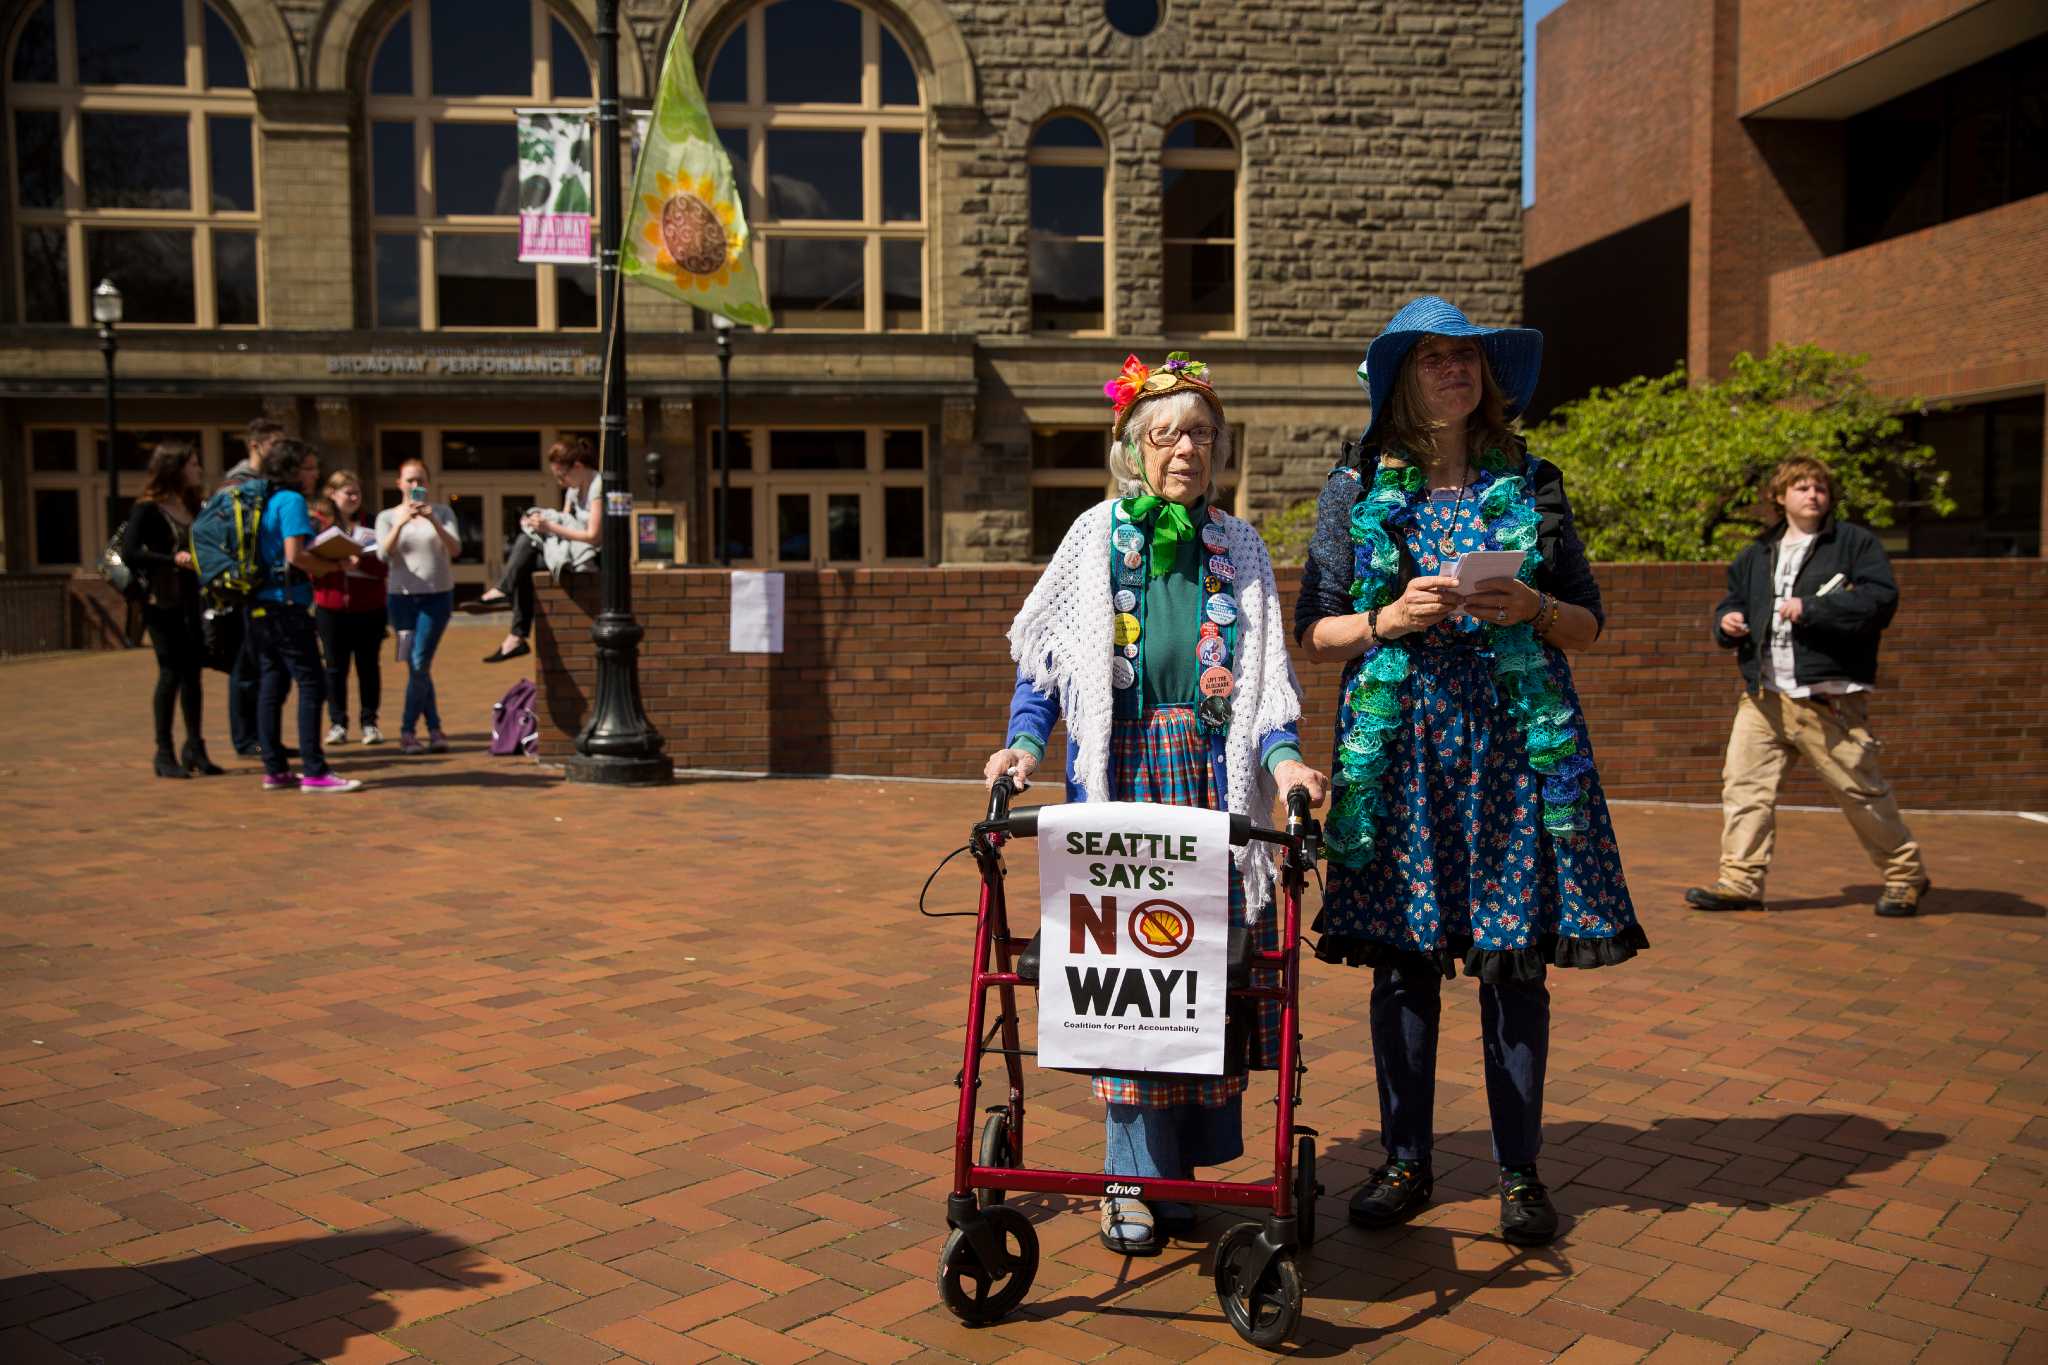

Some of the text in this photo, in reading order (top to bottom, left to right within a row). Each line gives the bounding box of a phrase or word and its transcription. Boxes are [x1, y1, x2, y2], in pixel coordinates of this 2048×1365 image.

[327, 355, 426, 374] BROADWAY
[436, 355, 576, 374] PERFORMANCE
[1066, 831, 1198, 862] SEATTLE
[1088, 862, 1174, 891] SAYS:
[1064, 965, 1198, 1019] WAY!
[1063, 1021, 1200, 1034] Coalition for Port Accountability
[1106, 1182, 1141, 1196] drive
